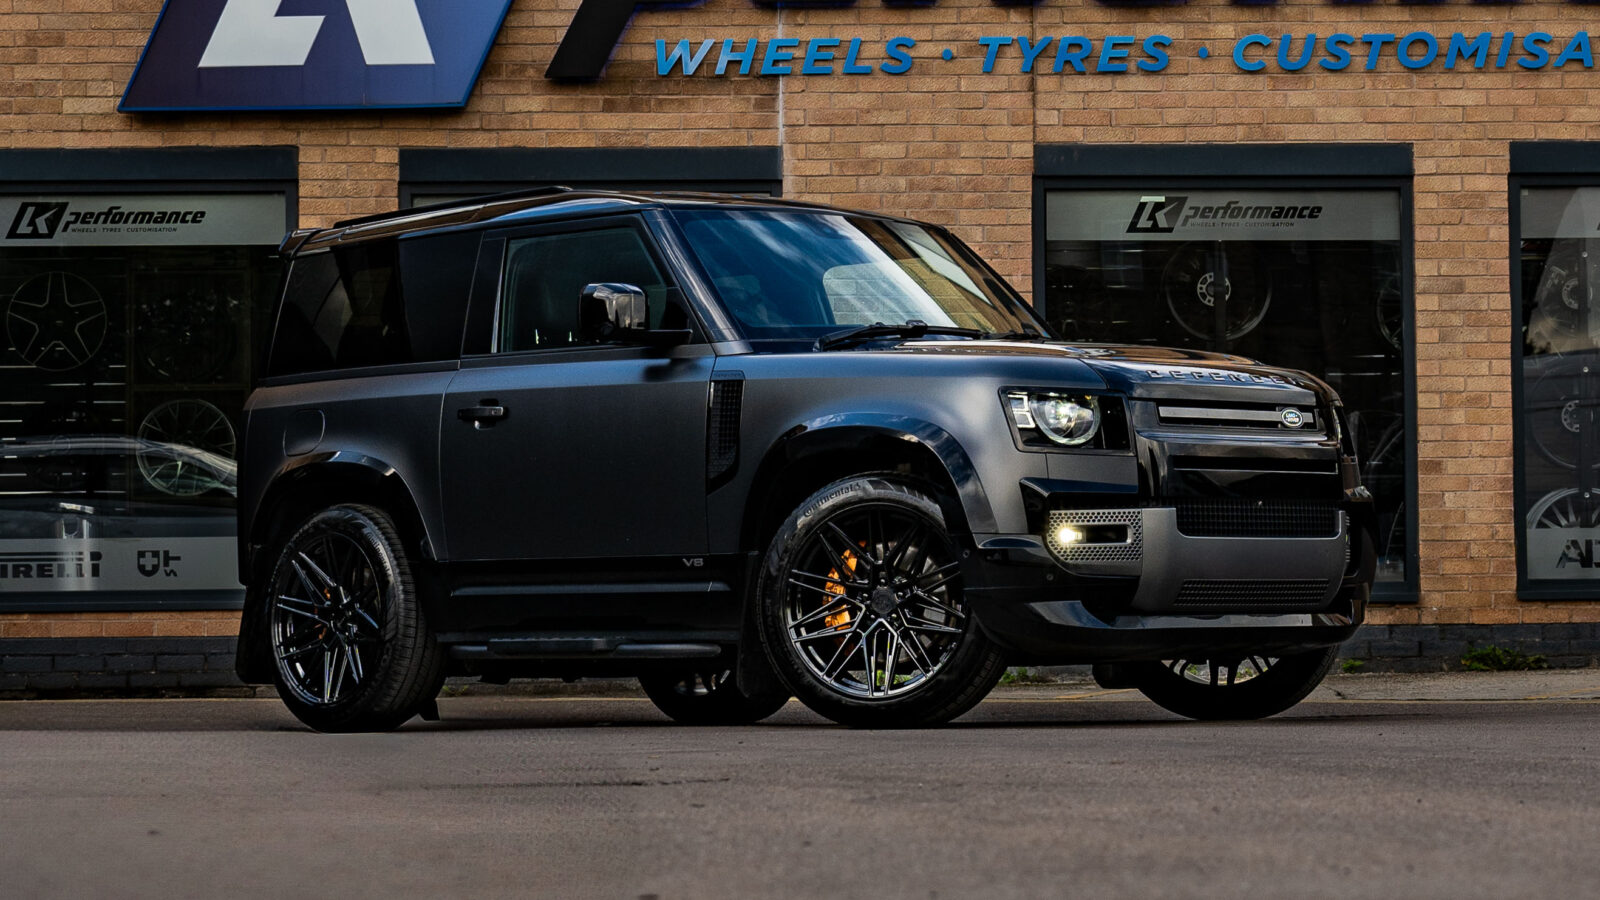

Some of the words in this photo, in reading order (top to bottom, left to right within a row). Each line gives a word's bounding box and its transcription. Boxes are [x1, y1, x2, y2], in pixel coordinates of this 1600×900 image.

[655, 37, 915, 76] WHEELS
[978, 35, 1173, 73] TYRES
[1232, 31, 1594, 71] CUSTOMISA
[61, 206, 206, 232] performance
[1181, 201, 1323, 227] performance
[1145, 369, 1304, 386] DEFENDER
[803, 483, 855, 518] Continental
[682, 558, 704, 567] V8
